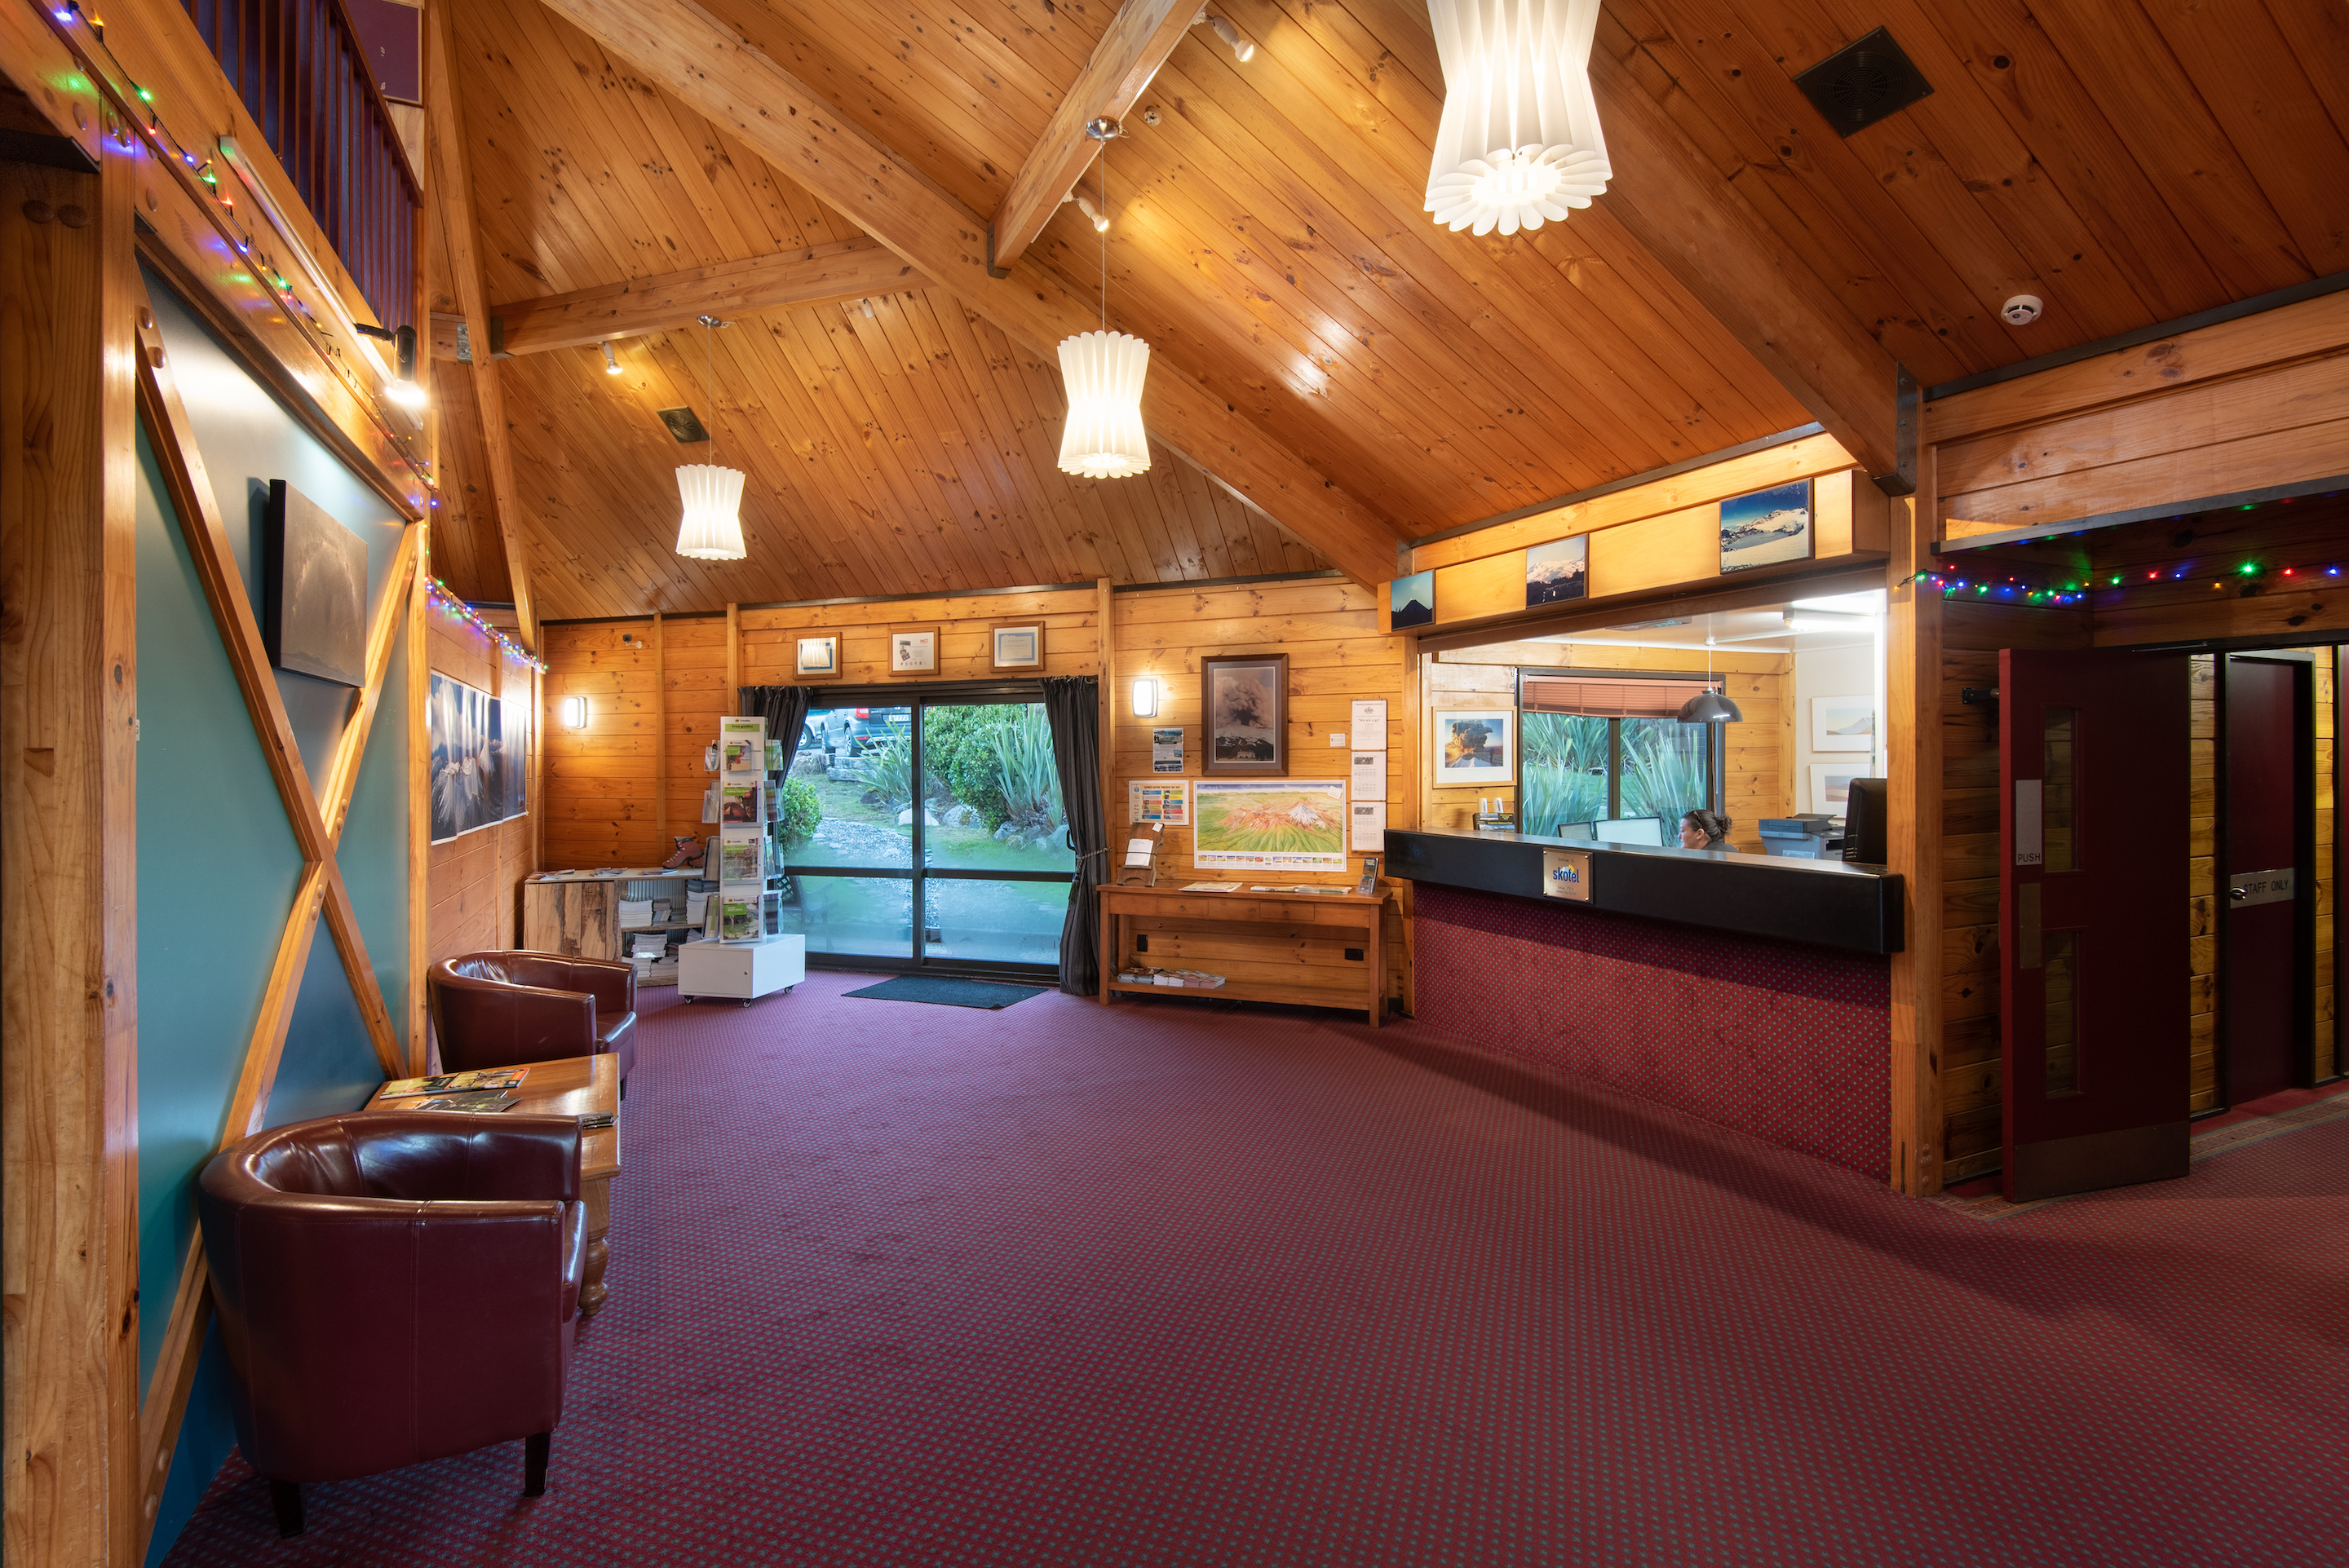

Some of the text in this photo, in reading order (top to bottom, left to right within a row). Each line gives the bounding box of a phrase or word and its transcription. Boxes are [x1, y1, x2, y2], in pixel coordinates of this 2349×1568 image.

[2018, 853, 2041, 863] PUSH
[1552, 867, 1580, 883] skotel
[2244, 879, 2289, 894] STAFF ONLY
